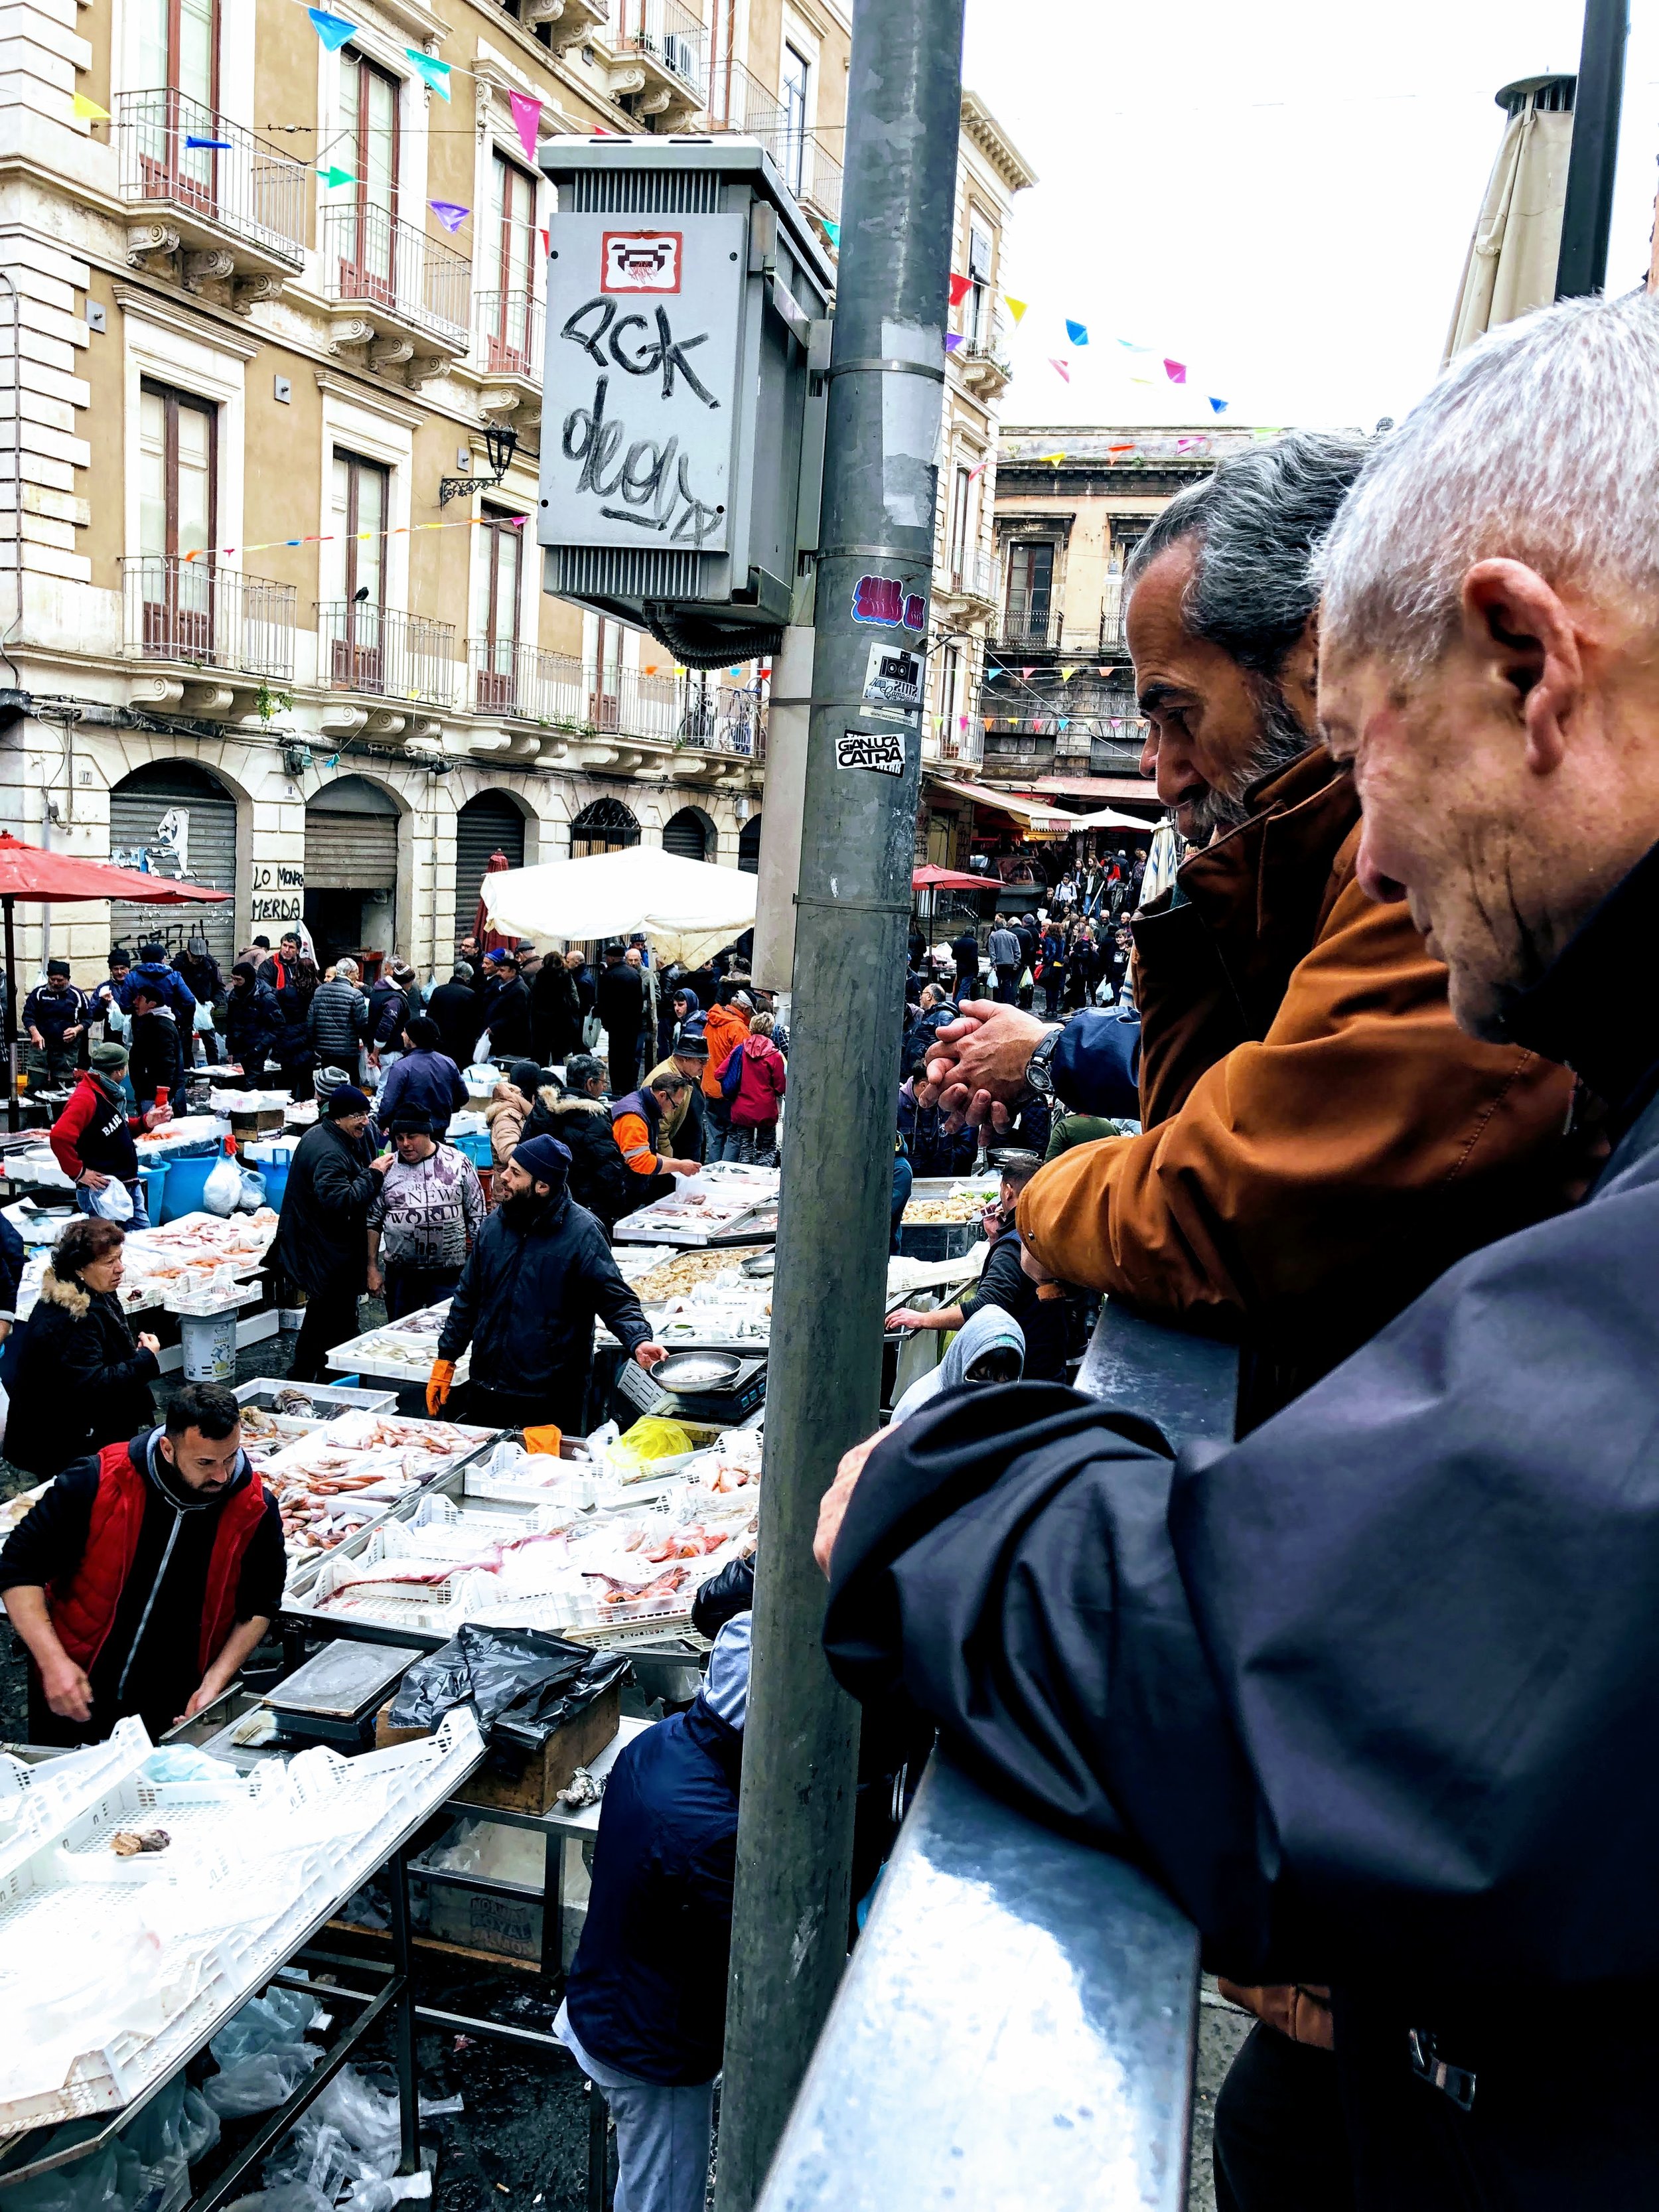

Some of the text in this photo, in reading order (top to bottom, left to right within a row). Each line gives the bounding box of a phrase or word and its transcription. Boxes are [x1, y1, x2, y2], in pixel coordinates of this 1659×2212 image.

[839, 747, 903, 767] CATRA
[83, 773, 90, 782] 17
[254, 866, 271, 889] LO
[253, 897, 300, 921] MERDA
[407, 1189, 461, 1205] NEWS
[389, 1205, 459, 1225] WORLD
[470, 1897, 527, 1921] NORWAY
[470, 1912, 532, 1940] ROYAL
